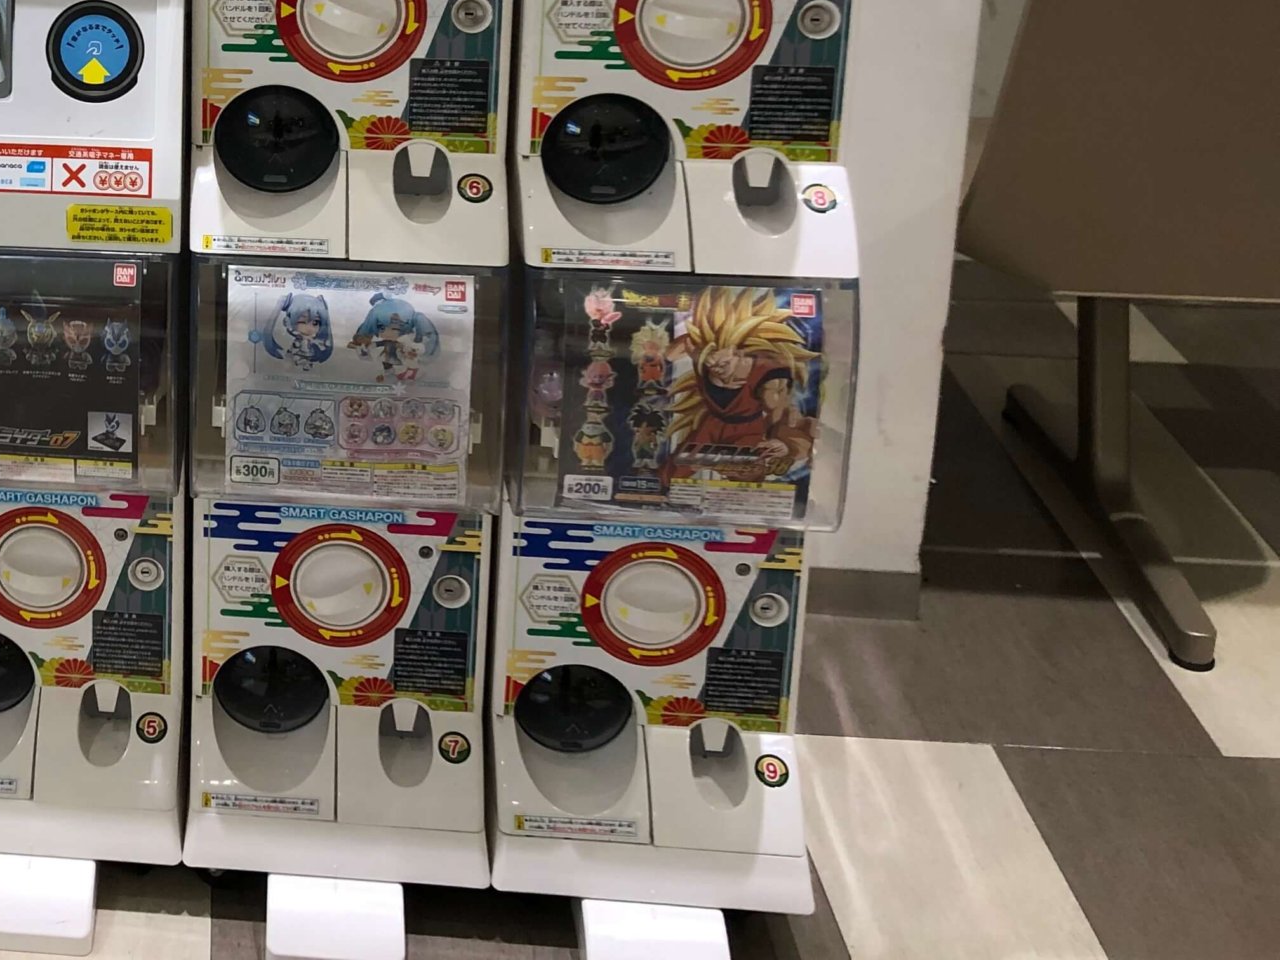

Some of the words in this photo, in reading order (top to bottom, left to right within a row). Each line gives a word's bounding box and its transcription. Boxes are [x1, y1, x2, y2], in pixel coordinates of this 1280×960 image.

[469, 180, 481, 196] 6
[814, 190, 827, 207] 8
[26, 492, 96, 506] GASHAPON
[280, 506, 325, 519] SMART
[329, 508, 404, 523] GASHAPON
[593, 525, 641, 538] SMART
[644, 527, 720, 541] GASHAPON
[145, 719, 157, 737] 5
[449, 739, 461, 756] 7
[765, 762, 778, 780] 9
